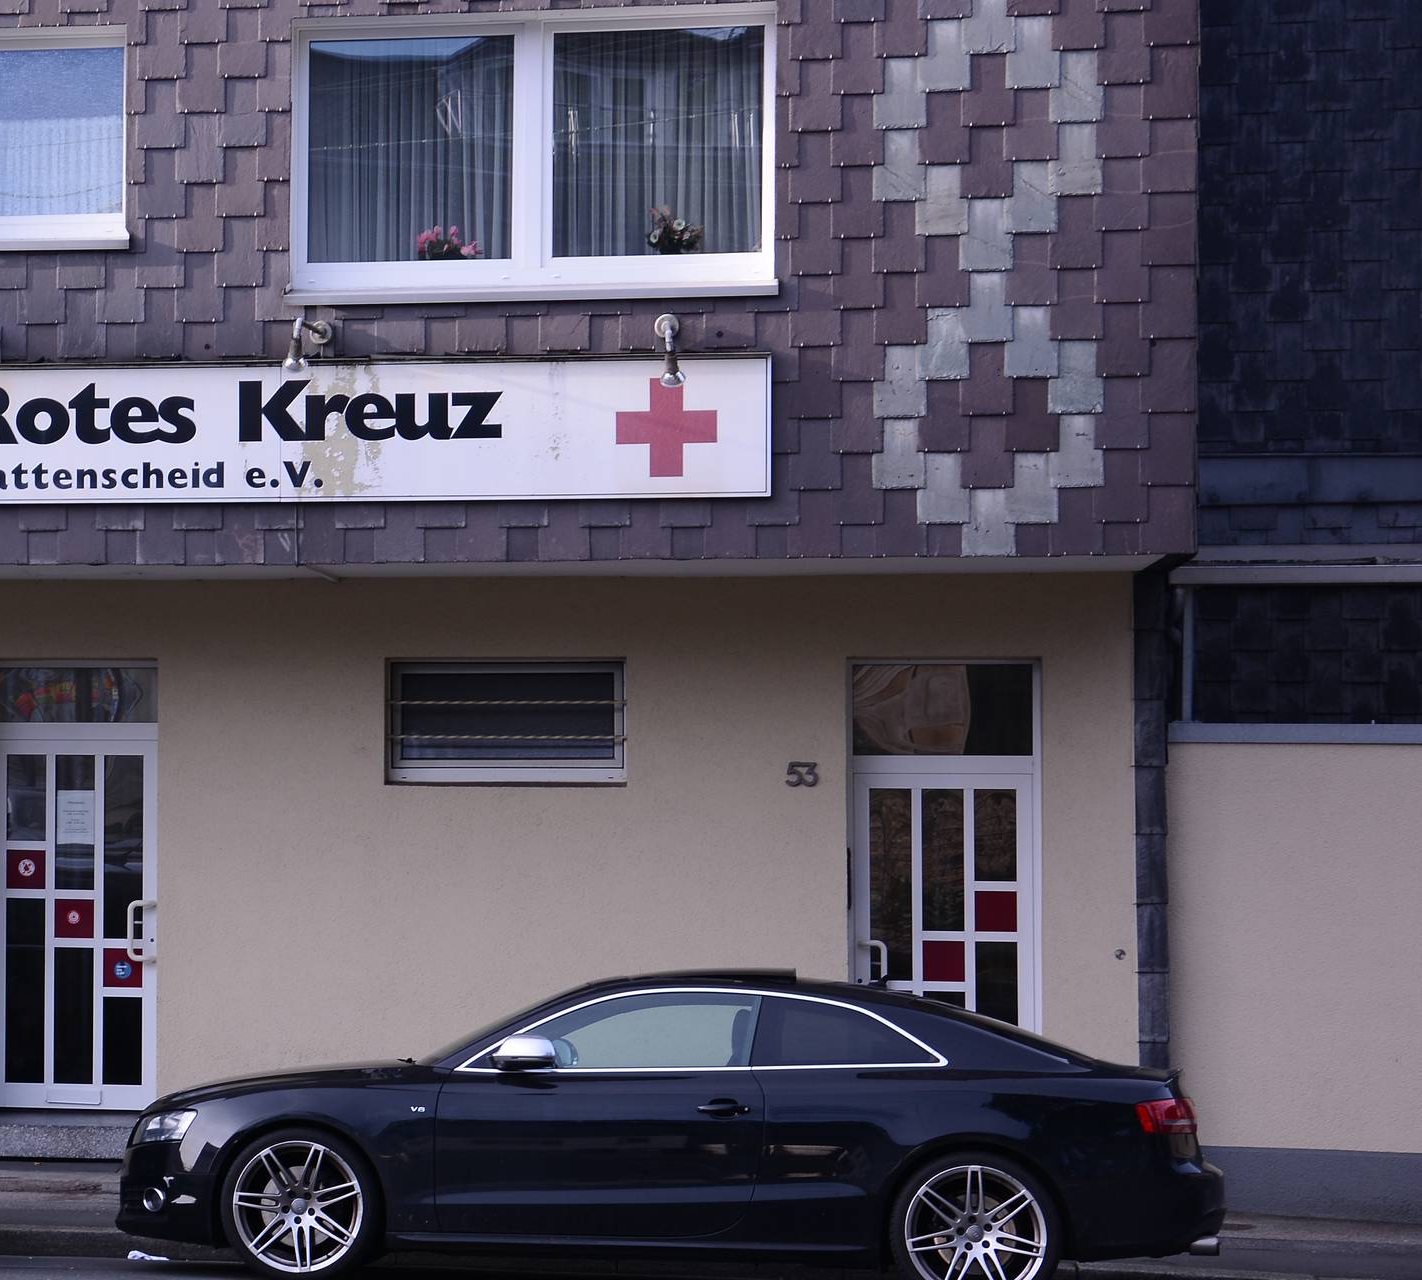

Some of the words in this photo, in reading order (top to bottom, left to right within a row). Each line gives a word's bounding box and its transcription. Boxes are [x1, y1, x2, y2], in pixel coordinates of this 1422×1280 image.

[238, 379, 504, 442] Kreuz
[245, 460, 324, 489] e.V.
[786, 761, 818, 787] 53
